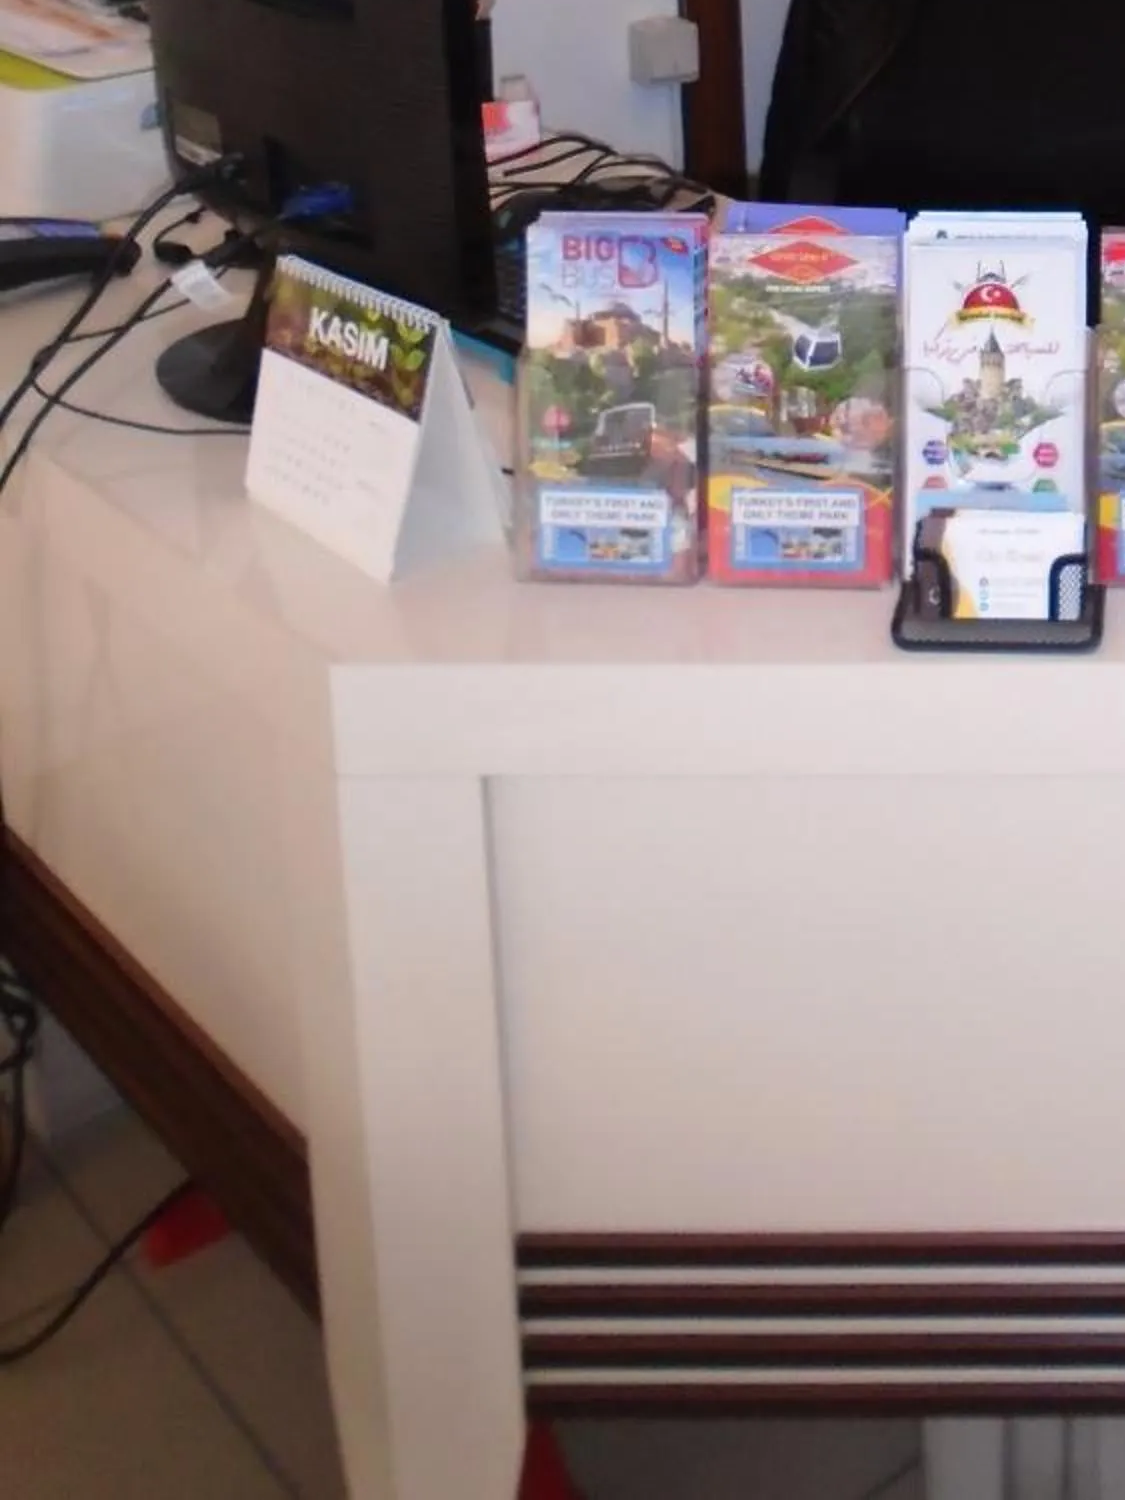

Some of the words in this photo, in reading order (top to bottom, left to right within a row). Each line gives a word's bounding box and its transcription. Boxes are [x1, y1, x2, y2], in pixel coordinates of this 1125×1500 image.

[563, 234, 614, 261] BIG
[562, 264, 615, 289] BUS
[309, 306, 389, 372] KASIM
